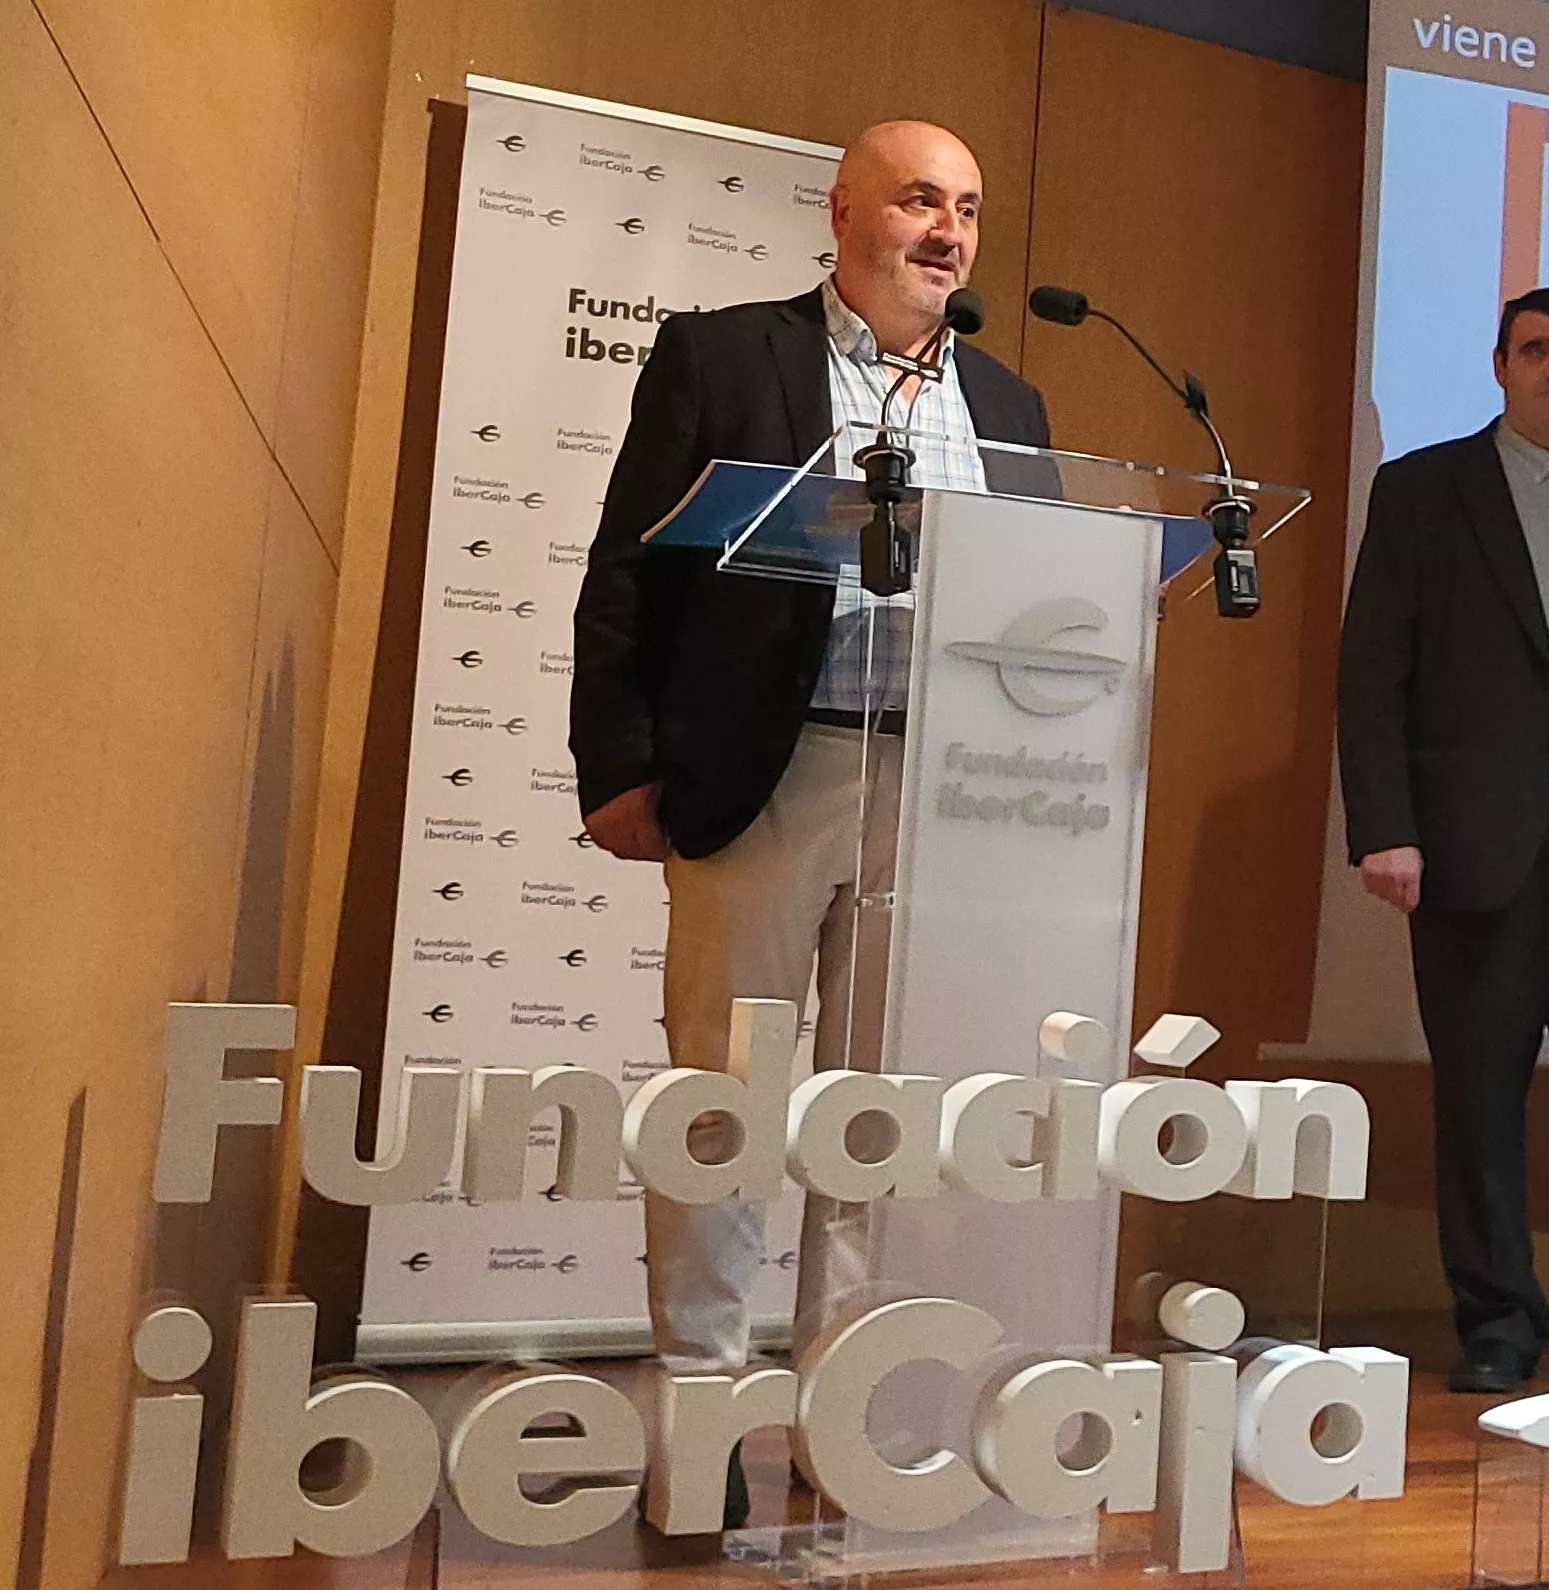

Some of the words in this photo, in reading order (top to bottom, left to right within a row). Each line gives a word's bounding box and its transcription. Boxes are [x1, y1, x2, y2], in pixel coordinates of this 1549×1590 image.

[1414, 17, 1536, 69] viene
[568, 287, 680, 325] Funda
[565, 326, 654, 367] iber
[151, 998, 1371, 1205] Fundación
[117, 1278, 1411, 1575] iberCaja
